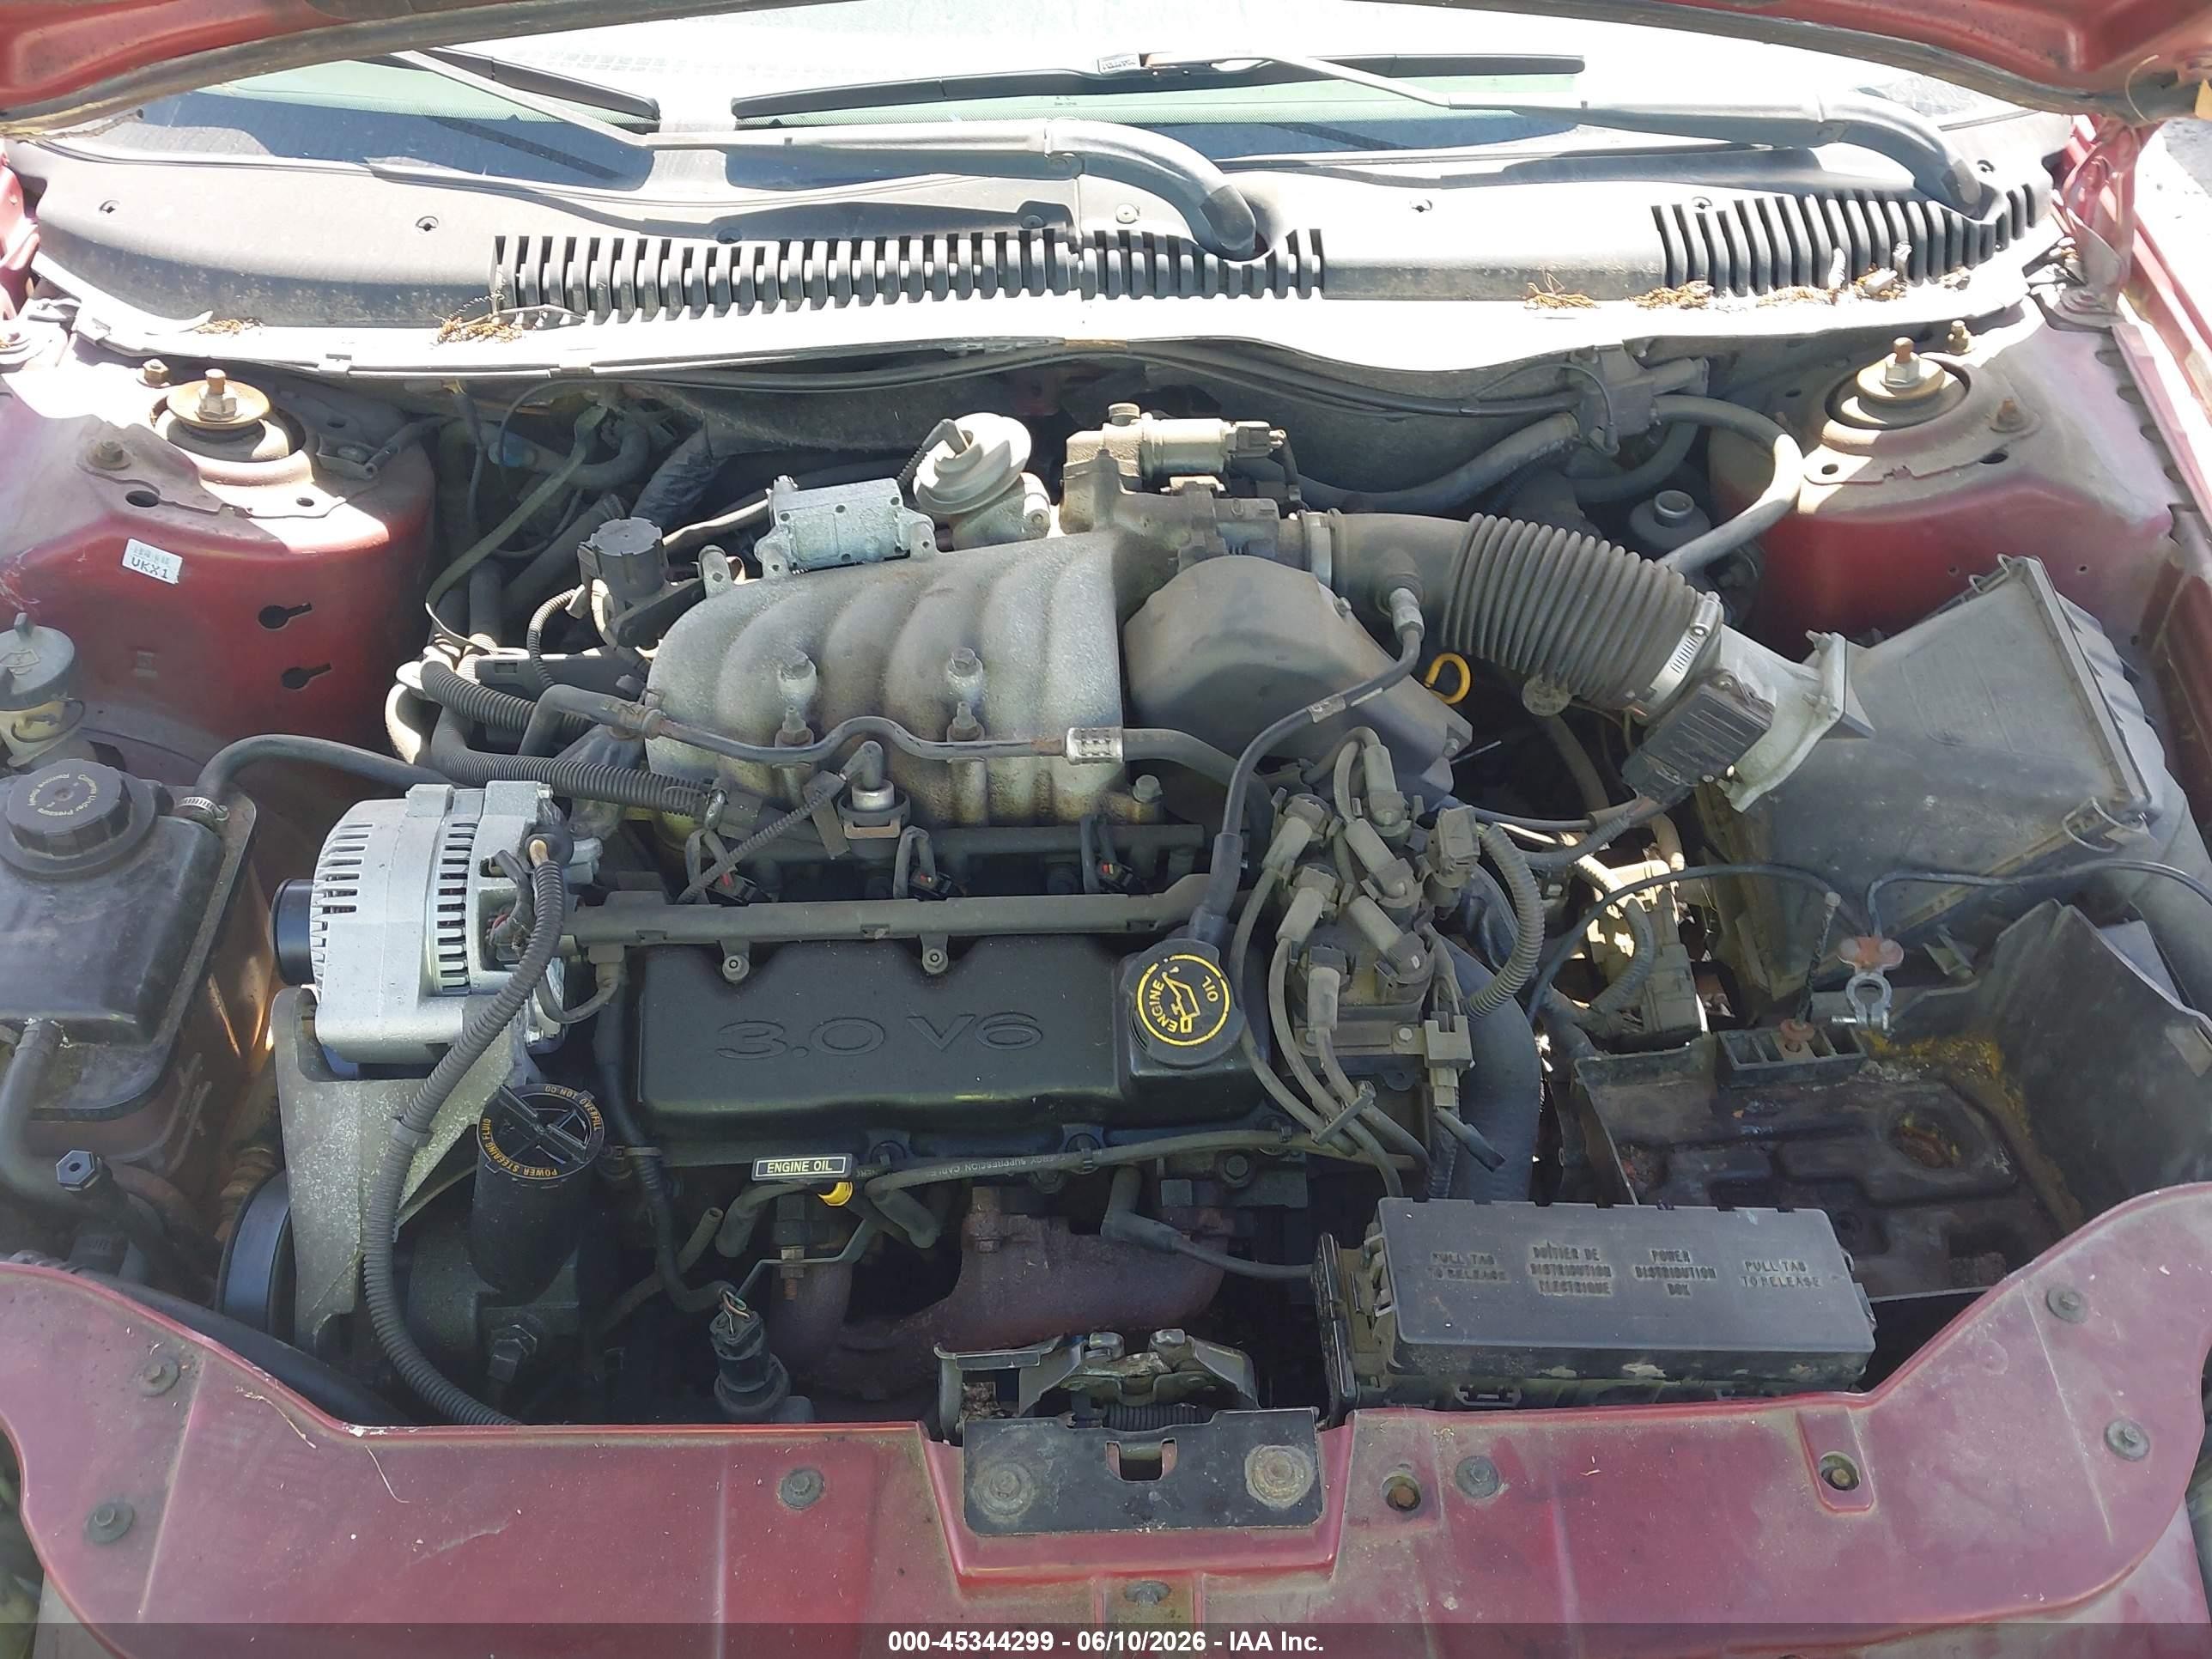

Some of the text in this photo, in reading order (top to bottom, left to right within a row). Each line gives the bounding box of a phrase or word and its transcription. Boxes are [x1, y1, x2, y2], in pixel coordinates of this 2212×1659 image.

[131, 556, 167, 579] UKX1
[1149, 975, 1218, 1033] ENGINE OIL
[715, 1012, 1042, 1060] 3.0 V6
[481, 1118, 557, 1176] POWER STEERING FLUID
[767, 1160, 833, 1173] ENGINE OIL
[1651, 1249, 1691, 1263] POWER
[1635, 1266, 1717, 1279] DISTRIBUTION
[1745, 1261, 1807, 1272] PULL TAB
[1741, 1276, 1821, 1288] TO RELEASE
